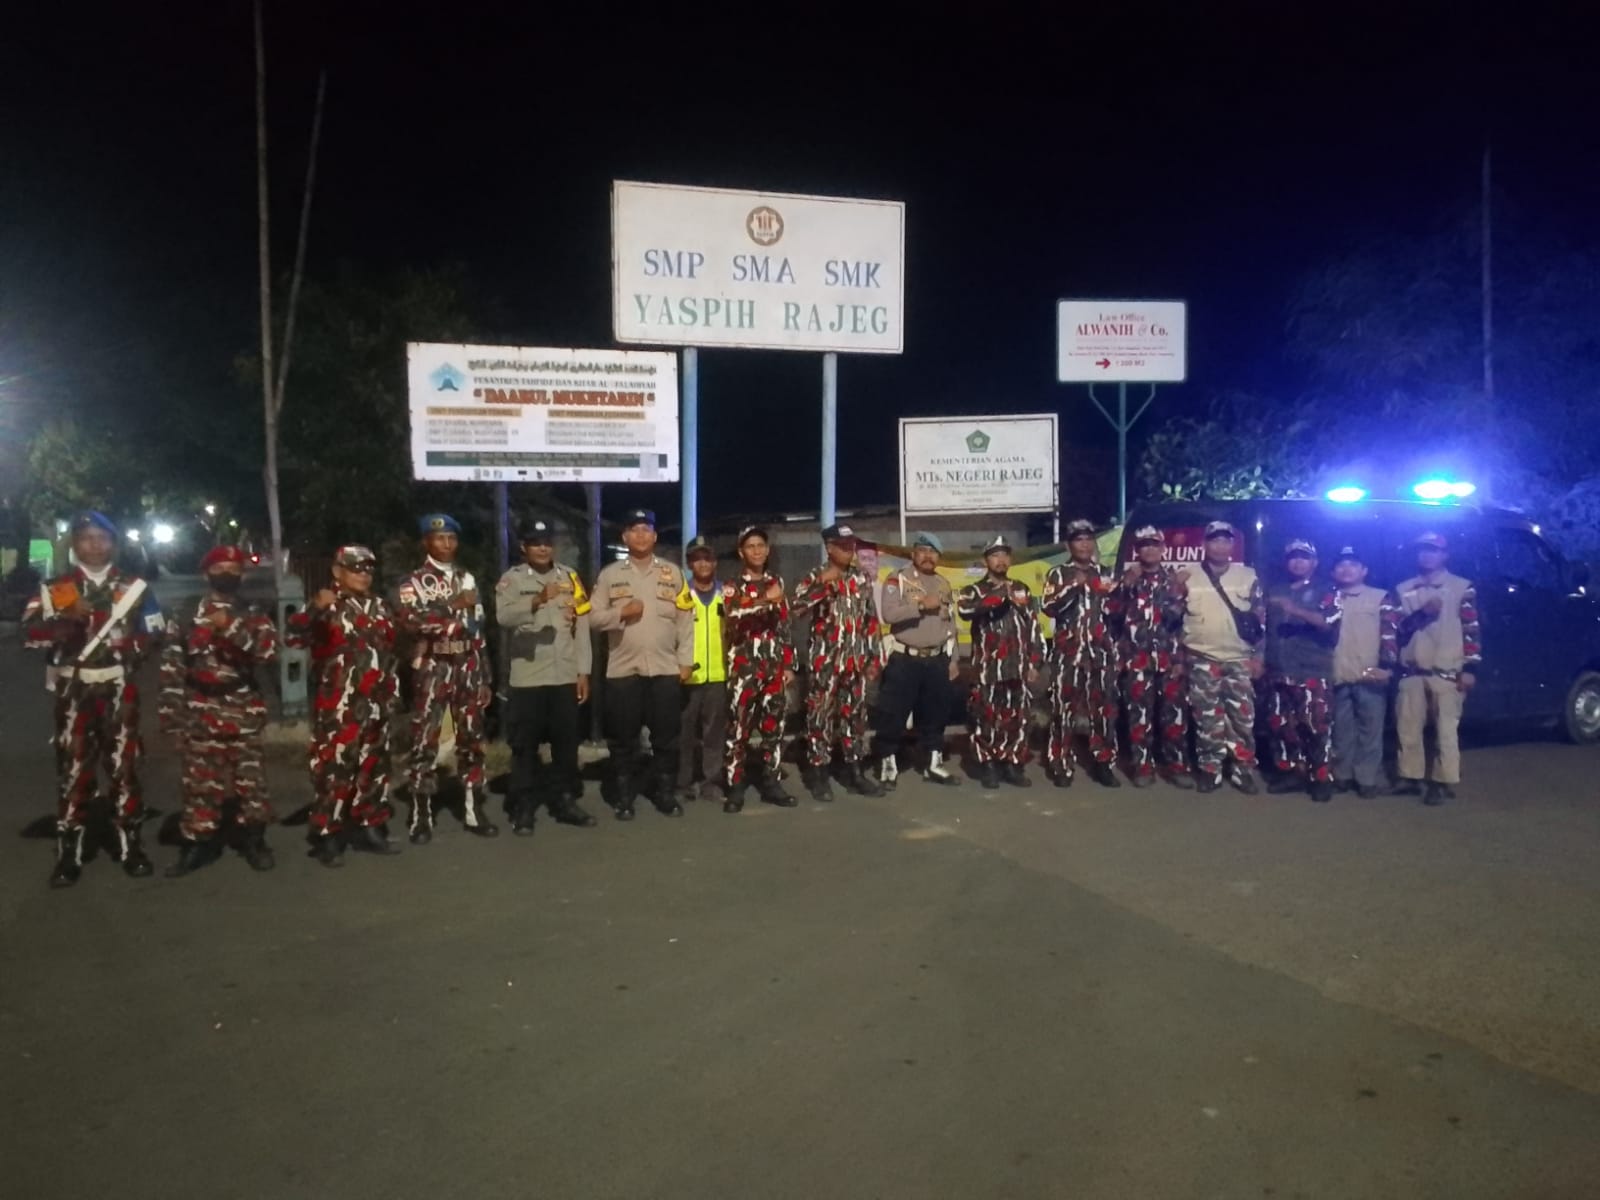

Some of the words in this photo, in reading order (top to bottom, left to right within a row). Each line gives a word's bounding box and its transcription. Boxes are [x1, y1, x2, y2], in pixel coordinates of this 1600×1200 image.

[643, 249, 705, 279] SMP
[732, 255, 796, 284] SMA
[824, 260, 881, 288] SMK
[633, 294, 755, 329] YASPIH
[783, 301, 889, 335] RAJEG
[1076, 323, 1134, 336] ALWANIH
[1150, 324, 1169, 336] Co.
[930, 457, 992, 465] KEMENTERIAN
[995, 456, 1026, 464] AGAMA
[946, 469, 997, 482] NEGERI
[999, 468, 1044, 482] RAJEG
